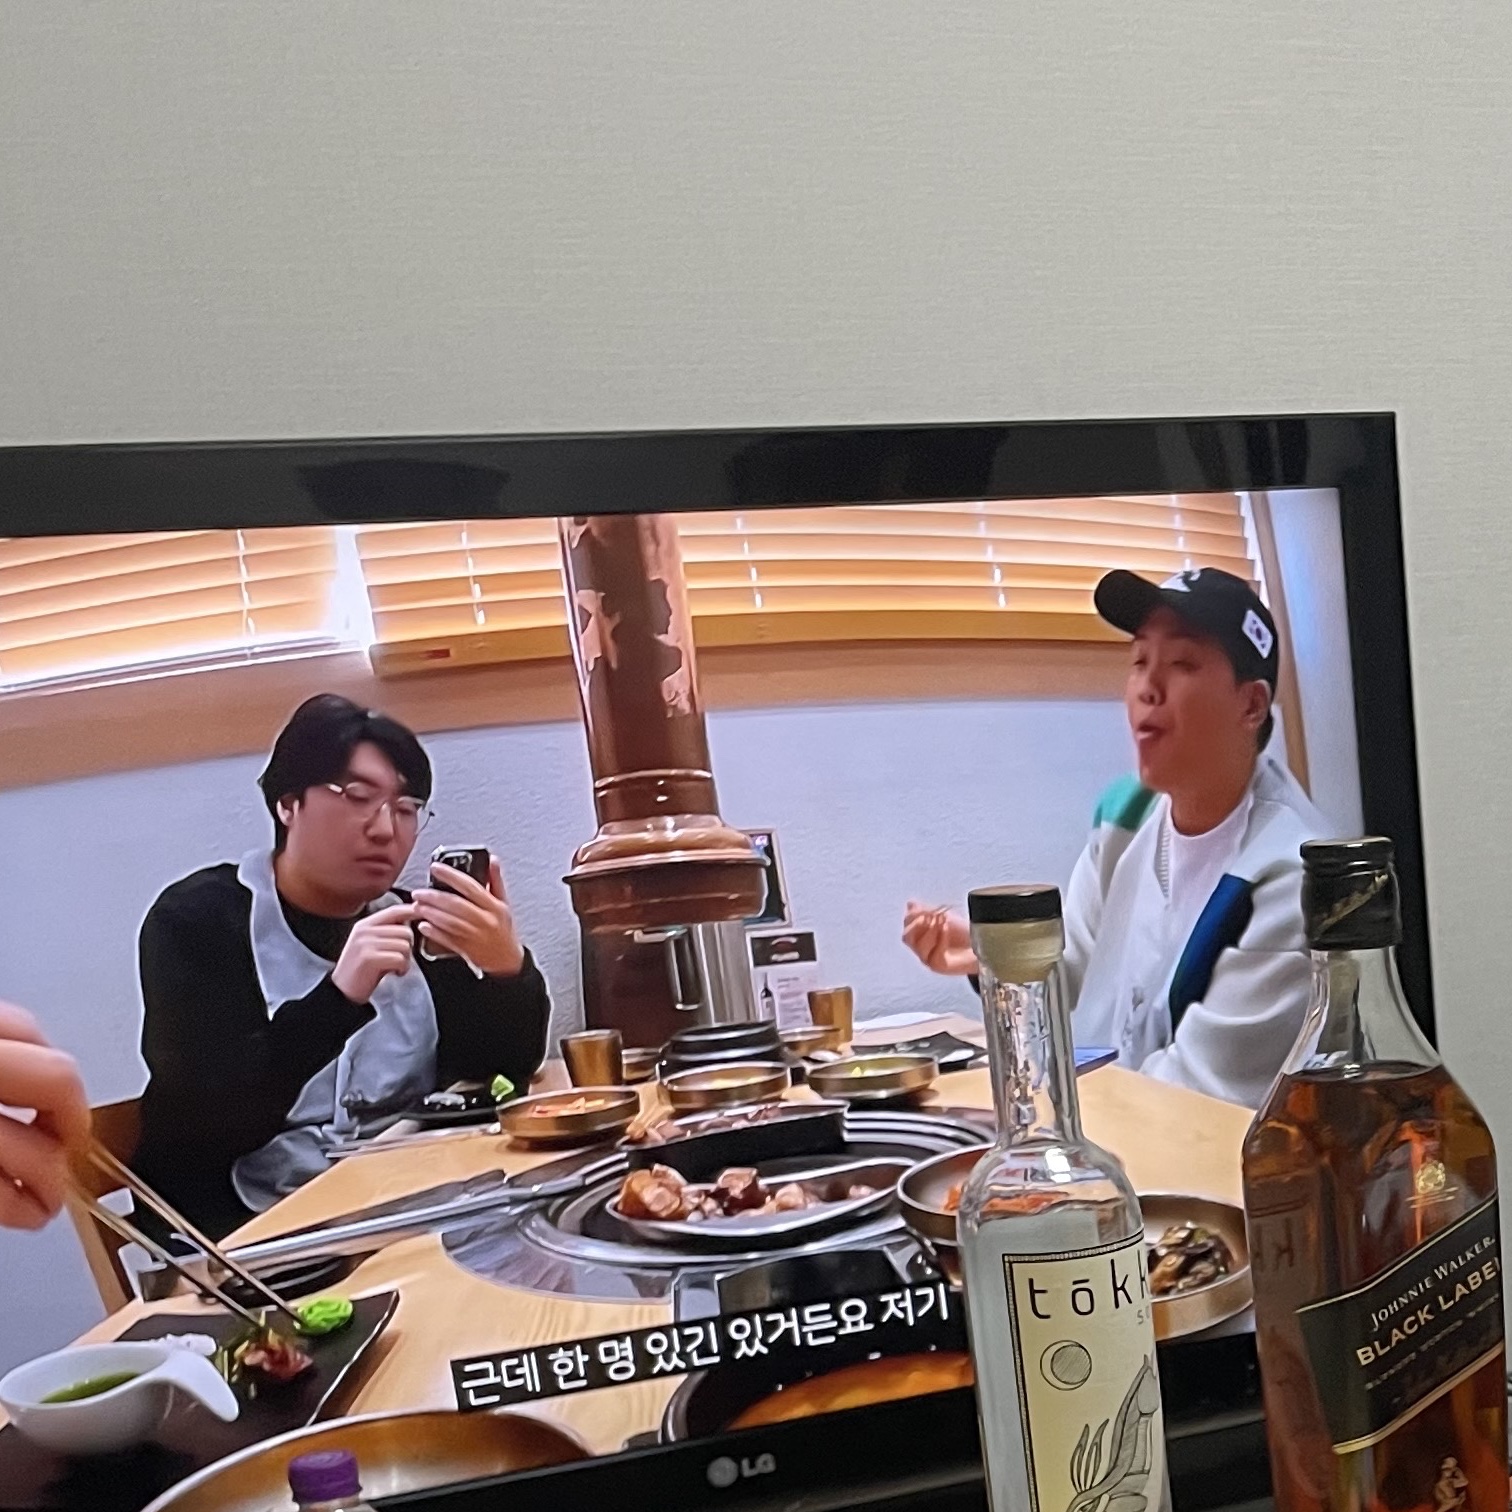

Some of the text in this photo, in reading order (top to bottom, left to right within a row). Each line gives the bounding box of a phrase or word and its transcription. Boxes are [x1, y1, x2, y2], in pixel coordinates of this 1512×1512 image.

[1371, 1276, 1433, 1331] JOHNNIE
[461, 1284, 949, 1406] 근데 한 명 있긴 있거든요 저기
[1356, 1304, 1435, 1366] BLACK
[741, 1452, 777, 1479] LG
